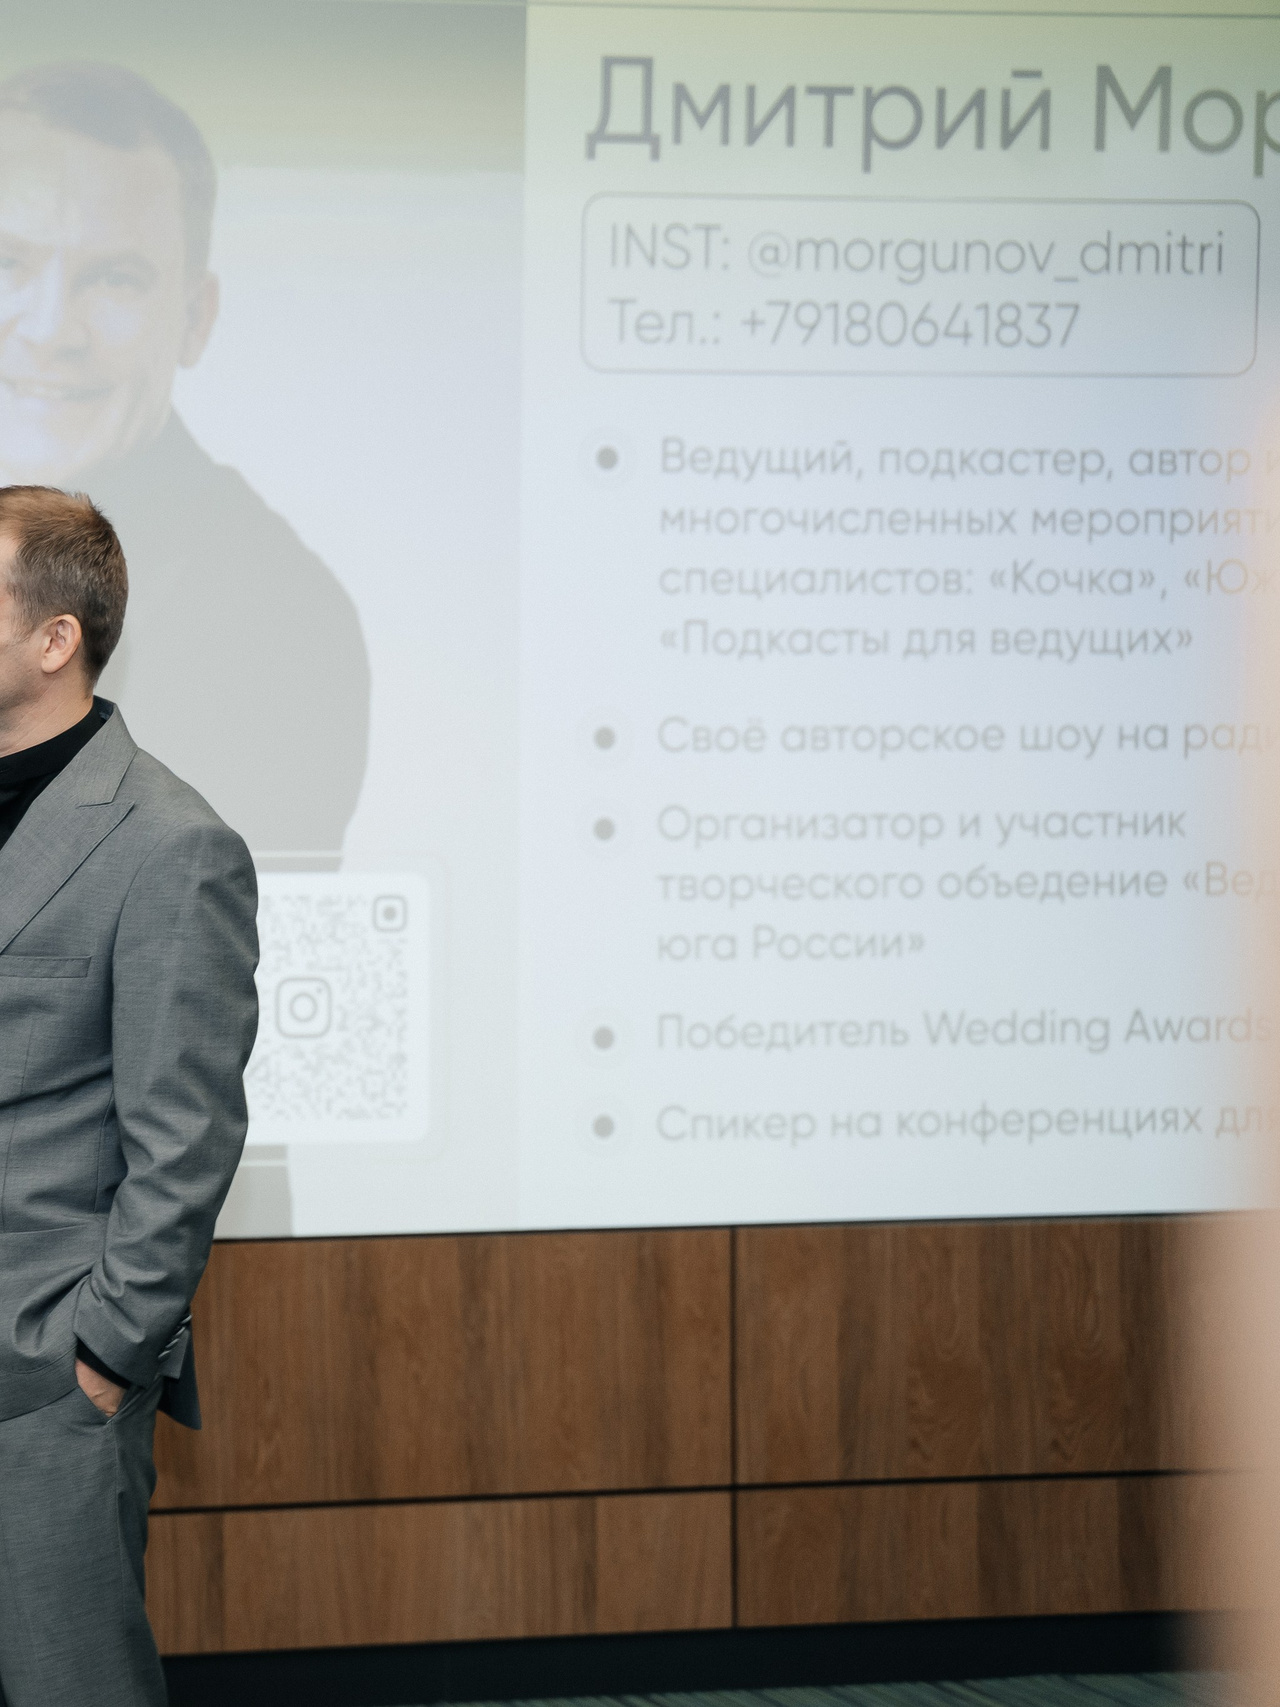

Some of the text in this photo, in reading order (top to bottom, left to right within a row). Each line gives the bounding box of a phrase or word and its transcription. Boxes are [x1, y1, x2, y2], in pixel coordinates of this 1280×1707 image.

[585, 55, 1052, 174] Дмитрий
[610, 221, 1224, 286] INST: @morgunov_dmitri
[607, 296, 1081, 349] Тел.: +79180641837
[660, 435, 864, 484] Ведущий,
[878, 447, 1114, 485] подкастер,
[1127, 448, 1252, 485] автор
[659, 506, 1017, 537] многочисленных
[658, 567, 973, 601] специалистов:
[989, 559, 1167, 601] «Кочка»,
[659, 617, 1193, 664] «Подкасты для ведущих»
[656, 714, 768, 754] Своё
[780, 723, 1007, 761] авторское
[1019, 723, 1105, 761] шоу
[1117, 723, 1169, 752] на
[656, 803, 1186, 850] Организатор и участник
[656, 871, 926, 909] творческого
[937, 863, 1169, 904] объедение
[657, 923, 926, 963] юга России»
[657, 1012, 911, 1053] Победитель
[922, 1009, 1111, 1055] Wedding
[655, 1103, 818, 1149] Спикер
[830, 1110, 883, 1140] на
[896, 1102, 1202, 1145] конференциях
